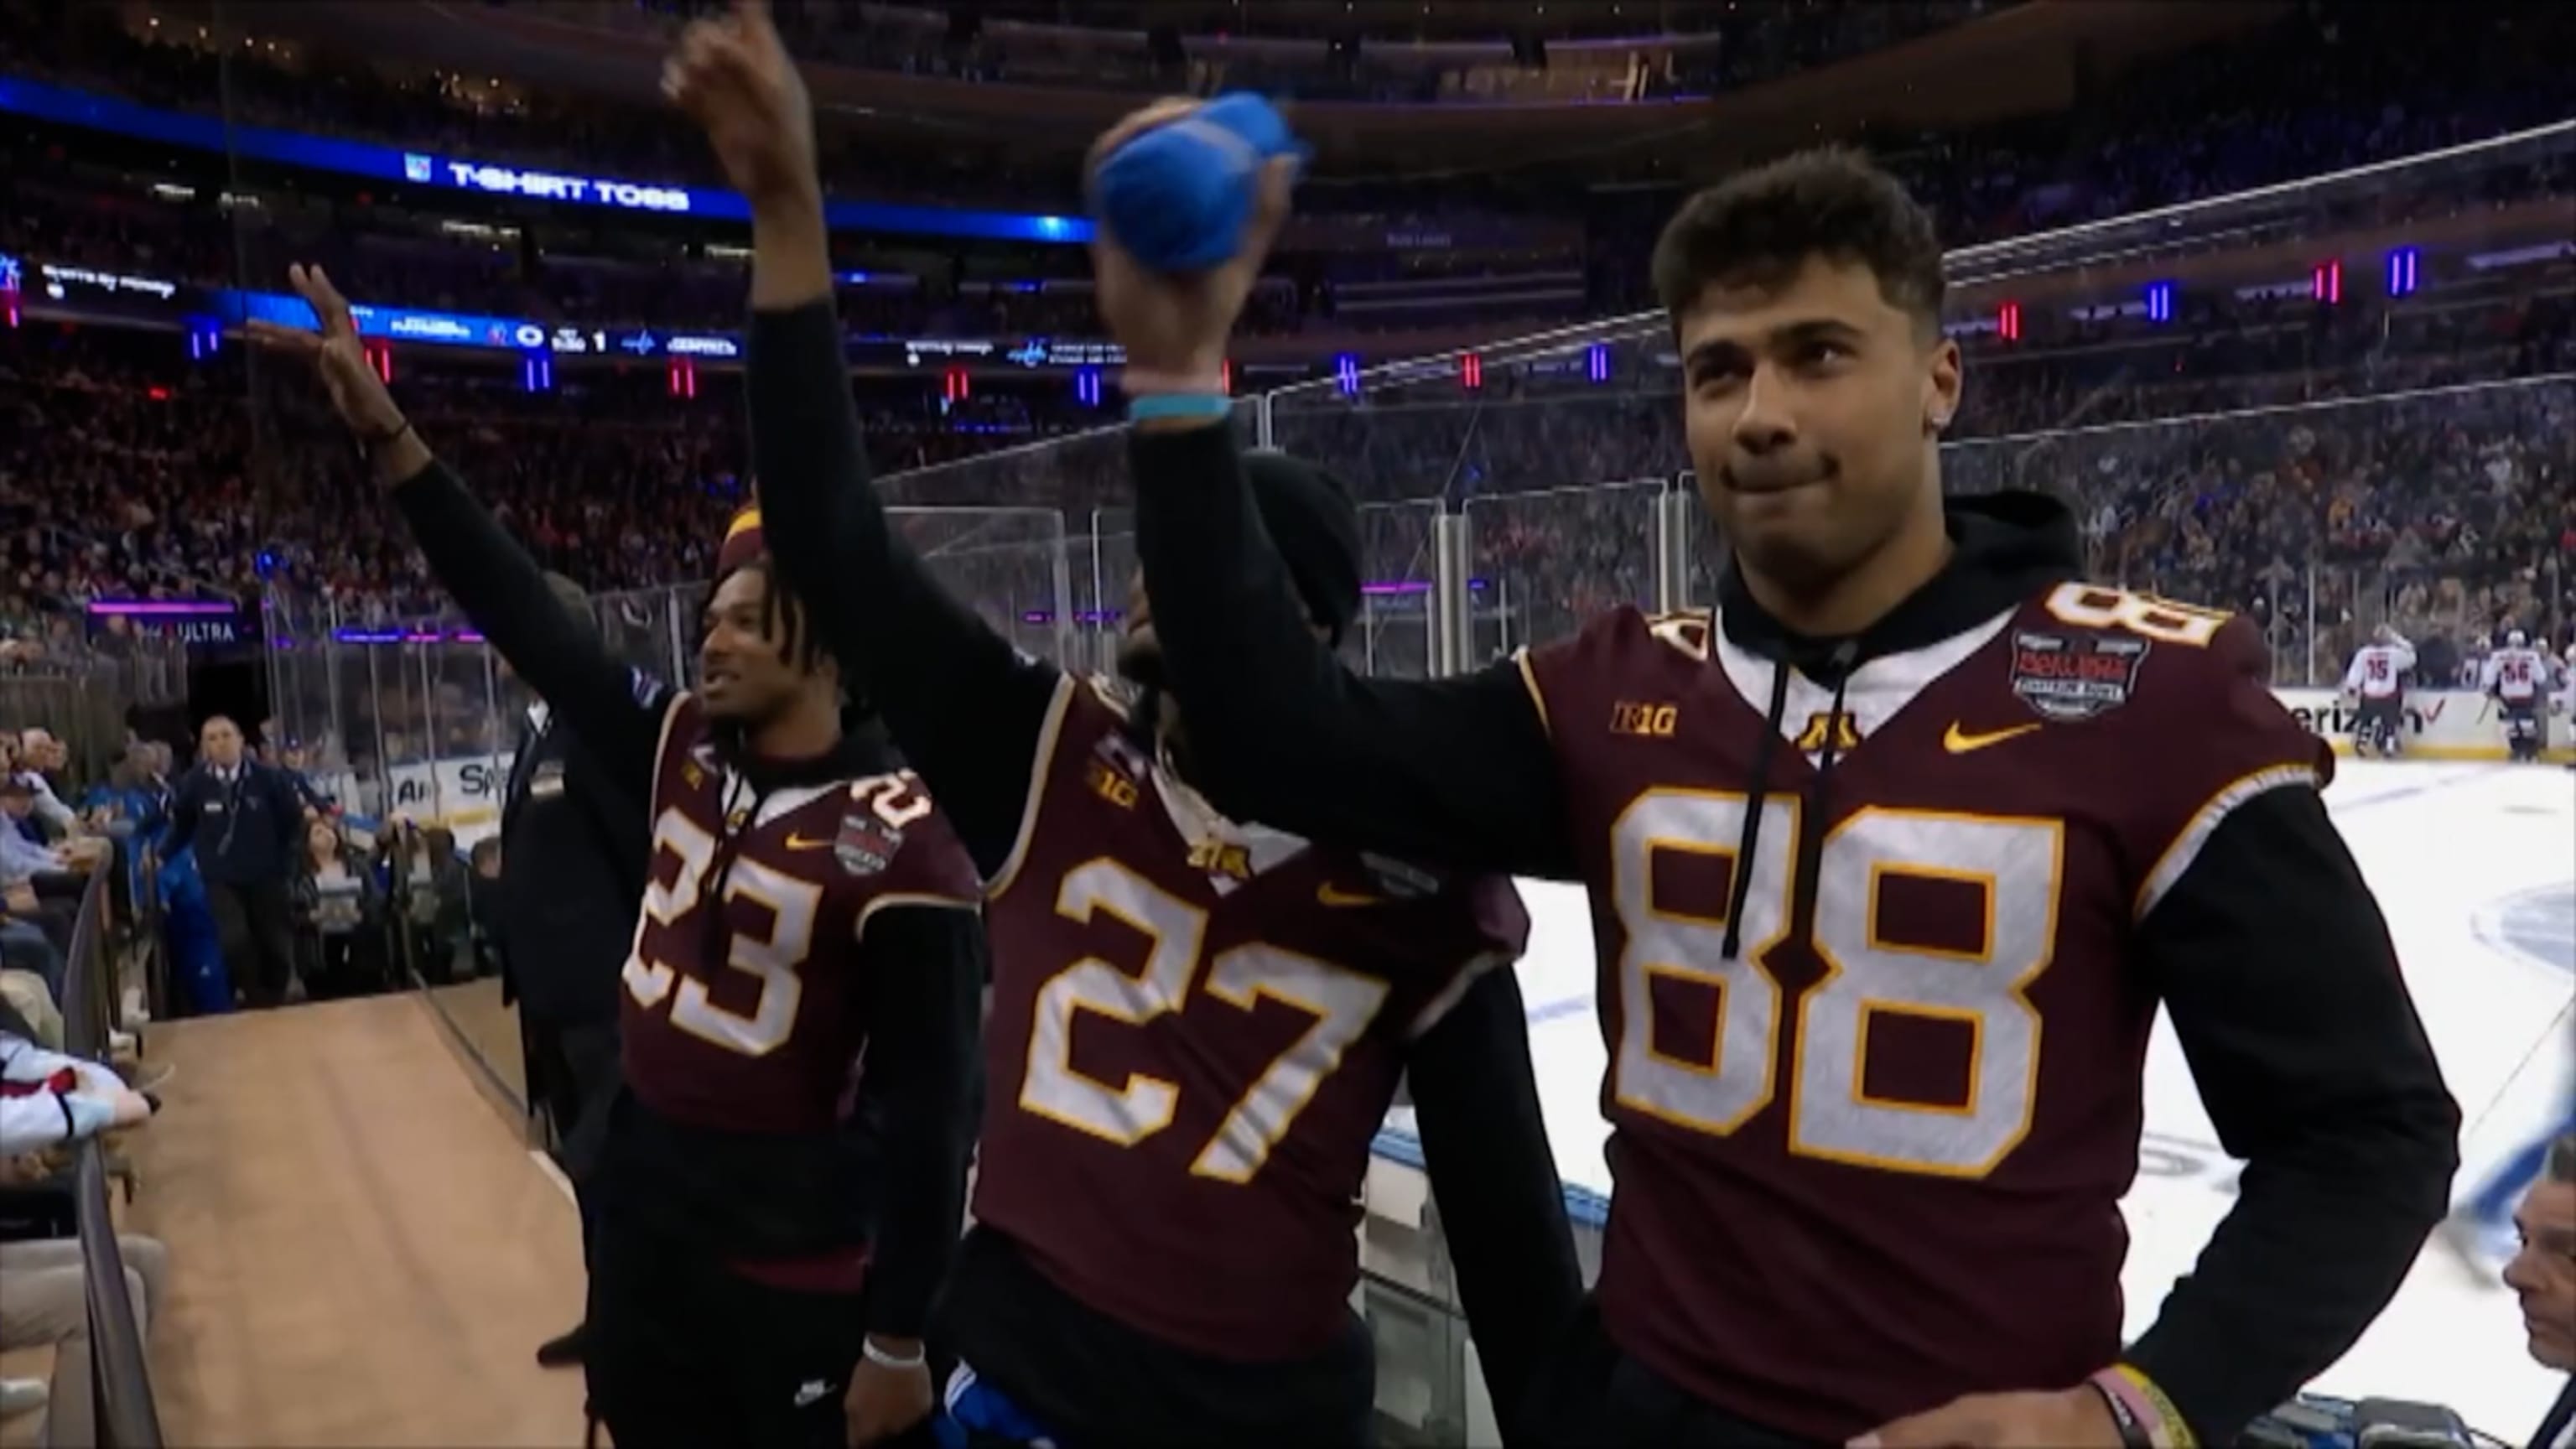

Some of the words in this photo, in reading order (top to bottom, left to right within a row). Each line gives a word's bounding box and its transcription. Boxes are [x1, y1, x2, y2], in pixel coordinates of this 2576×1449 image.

[448, 162, 589, 200] T-SHIRT
[593, 330, 605, 352] 1
[178, 622, 235, 643] ULTRA
[621, 803, 824, 1058] 23
[1610, 786, 2065, 1181] 88
[1019, 855, 1391, 1185] 27
